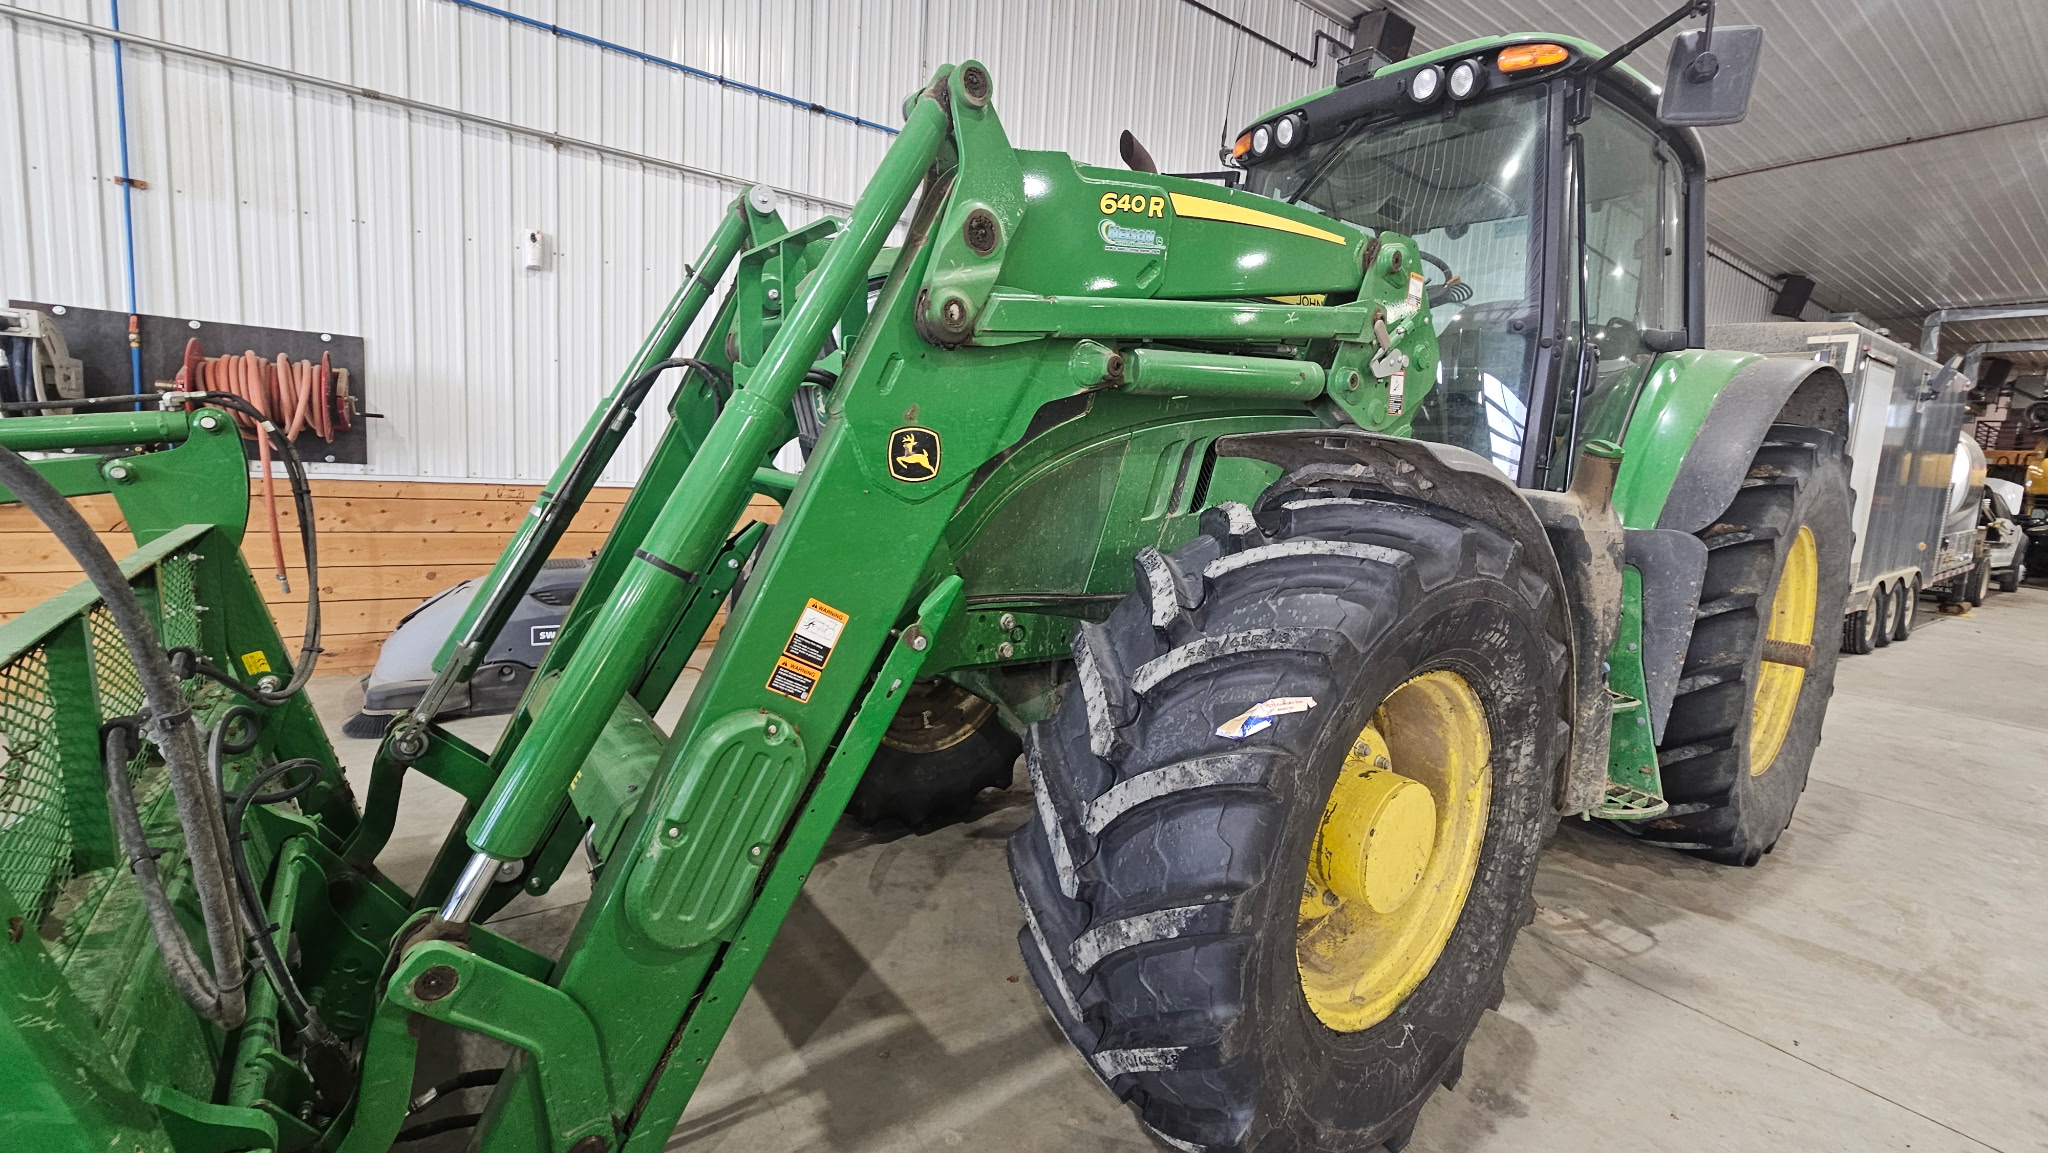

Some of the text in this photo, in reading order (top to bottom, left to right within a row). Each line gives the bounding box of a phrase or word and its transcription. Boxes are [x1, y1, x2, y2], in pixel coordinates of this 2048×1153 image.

[1100, 192, 1165, 218] 640 R
[1107, 226, 1156, 244] NELSON
[818, 605, 844, 621] WARNING
[539, 631, 556, 640] SW
[790, 663, 816, 678] WARNING
